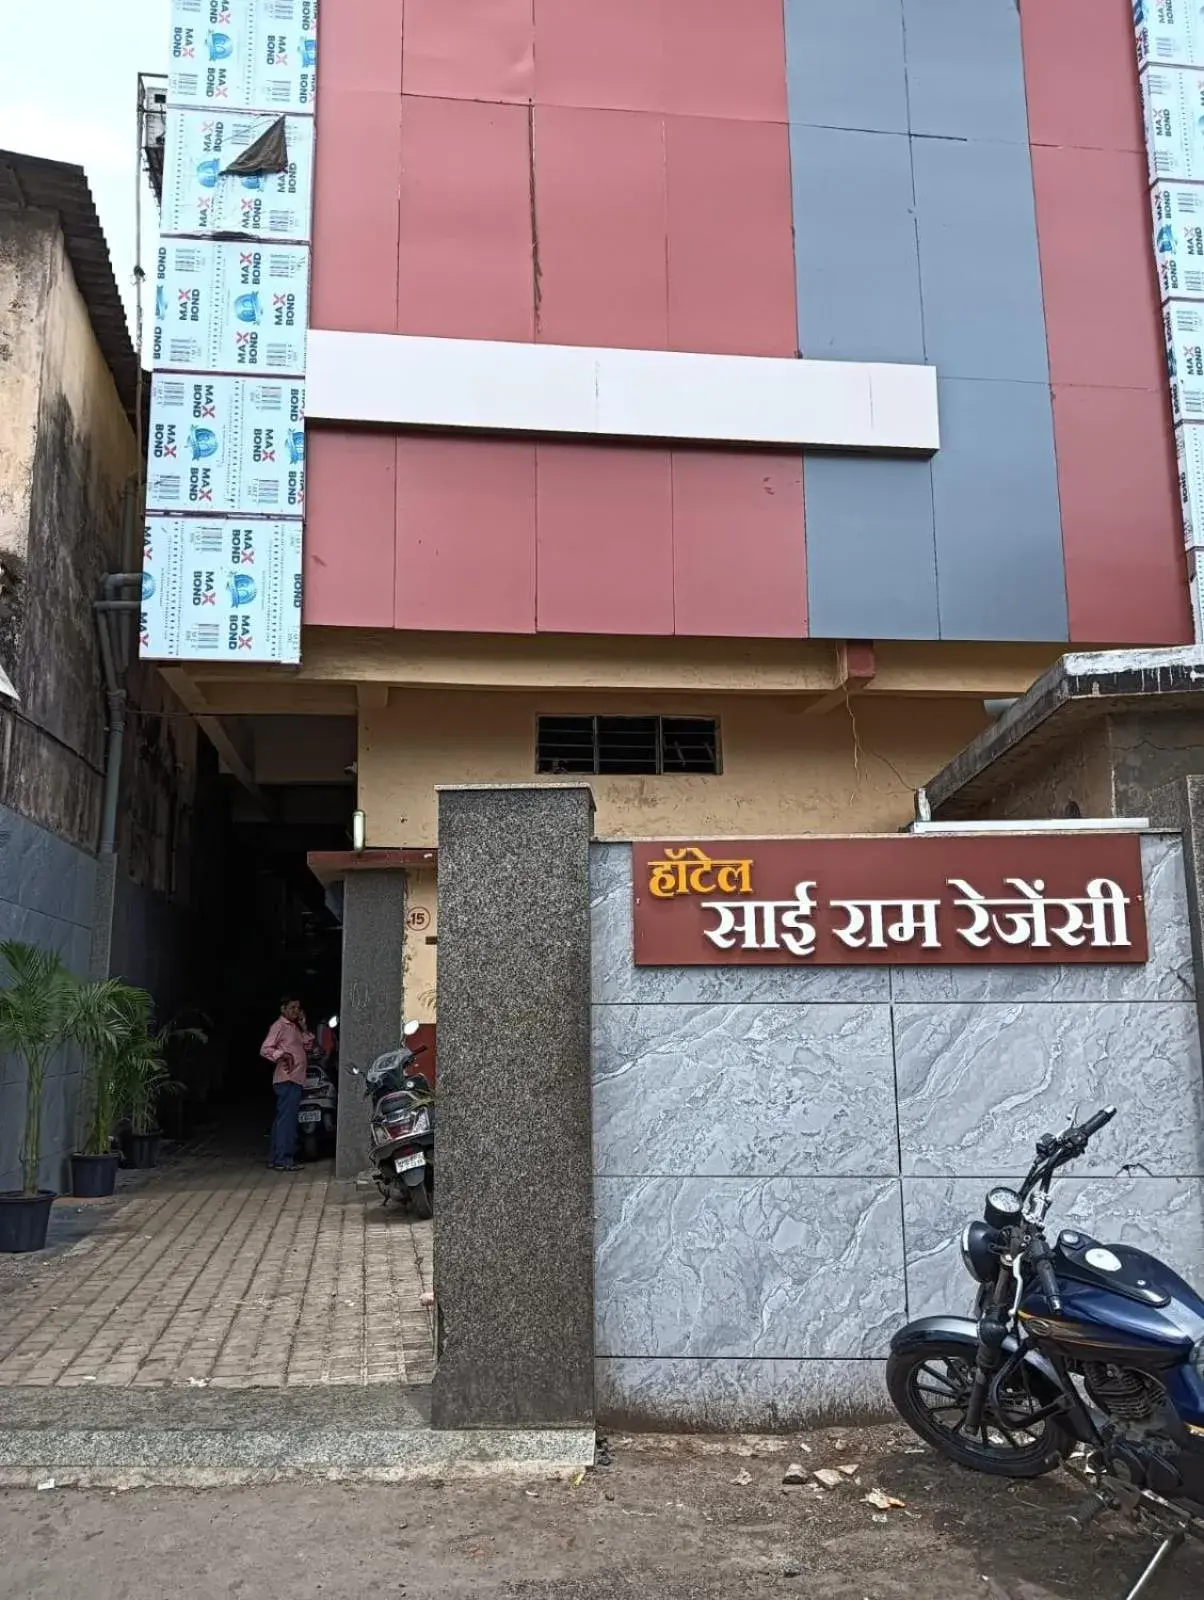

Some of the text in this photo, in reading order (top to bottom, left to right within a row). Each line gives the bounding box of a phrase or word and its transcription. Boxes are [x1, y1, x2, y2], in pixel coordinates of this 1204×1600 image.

[302, 1, 310, 31] BOND
[173, 26, 182, 58] BOND
[182, 28, 194, 58] MAX
[266, 35, 276, 65] BOND
[276, 36, 288, 66] MAX
[206, 68, 216, 98] BOND
[215, 68, 228, 98] MAX
[300, 74, 308, 104] BOND
[202, 120, 214, 152] MAX
[213, 121, 224, 152] BOND
[1153, 108, 1164, 136] MAX
[1163, 108, 1172, 136] BOND
[288, 162, 297, 194] BOND
[197, 197, 210, 227] MAX
[241, 198, 253, 228] MAX
[252, 198, 262, 229] BOND
[1163, 190, 1172, 219] BOND
[1184, 226, 1195, 256] MAX
[1195, 226, 1204, 256] BOND
[158, 247, 166, 280] BOND
[240, 252, 252, 284] MAX
[252, 252, 262, 284] BOND
[1170, 260, 1178, 289] BOND
[178, 288, 191, 320] MAX
[190, 288, 200, 322] BOND
[273, 294, 286, 326] MAX
[286, 293, 296, 326] BOND
[153, 326, 162, 360] BOND
[236, 330, 250, 364] MAX
[249, 331, 258, 364] BOND
[1183, 346, 1195, 375] MAX
[1194, 346, 1204, 376] BOND
[192, 384, 202, 418] BOND
[202, 384, 216, 419] MAX
[290, 388, 299, 422] BOND
[154, 424, 164, 458] BOND
[164, 424, 177, 458] MAX
[252, 428, 262, 462] BOND
[262, 429, 276, 462] MAX
[189, 467, 199, 502] BOND
[198, 468, 212, 502] MAX
[288, 470, 297, 505] BOND
[1180, 472, 1188, 504] BOND
[231, 528, 241, 564] BOND
[241, 529, 255, 564] MAX
[192, 570, 202, 606] BOND
[202, 570, 216, 606] MAX
[228, 614, 238, 650] BOND
[238, 615, 252, 651] MAX
[647, 847, 754, 897] हॉटेल
[411, 912, 425, 925] 15
[701, 878, 1132, 956] साई राम रेजेंसी
